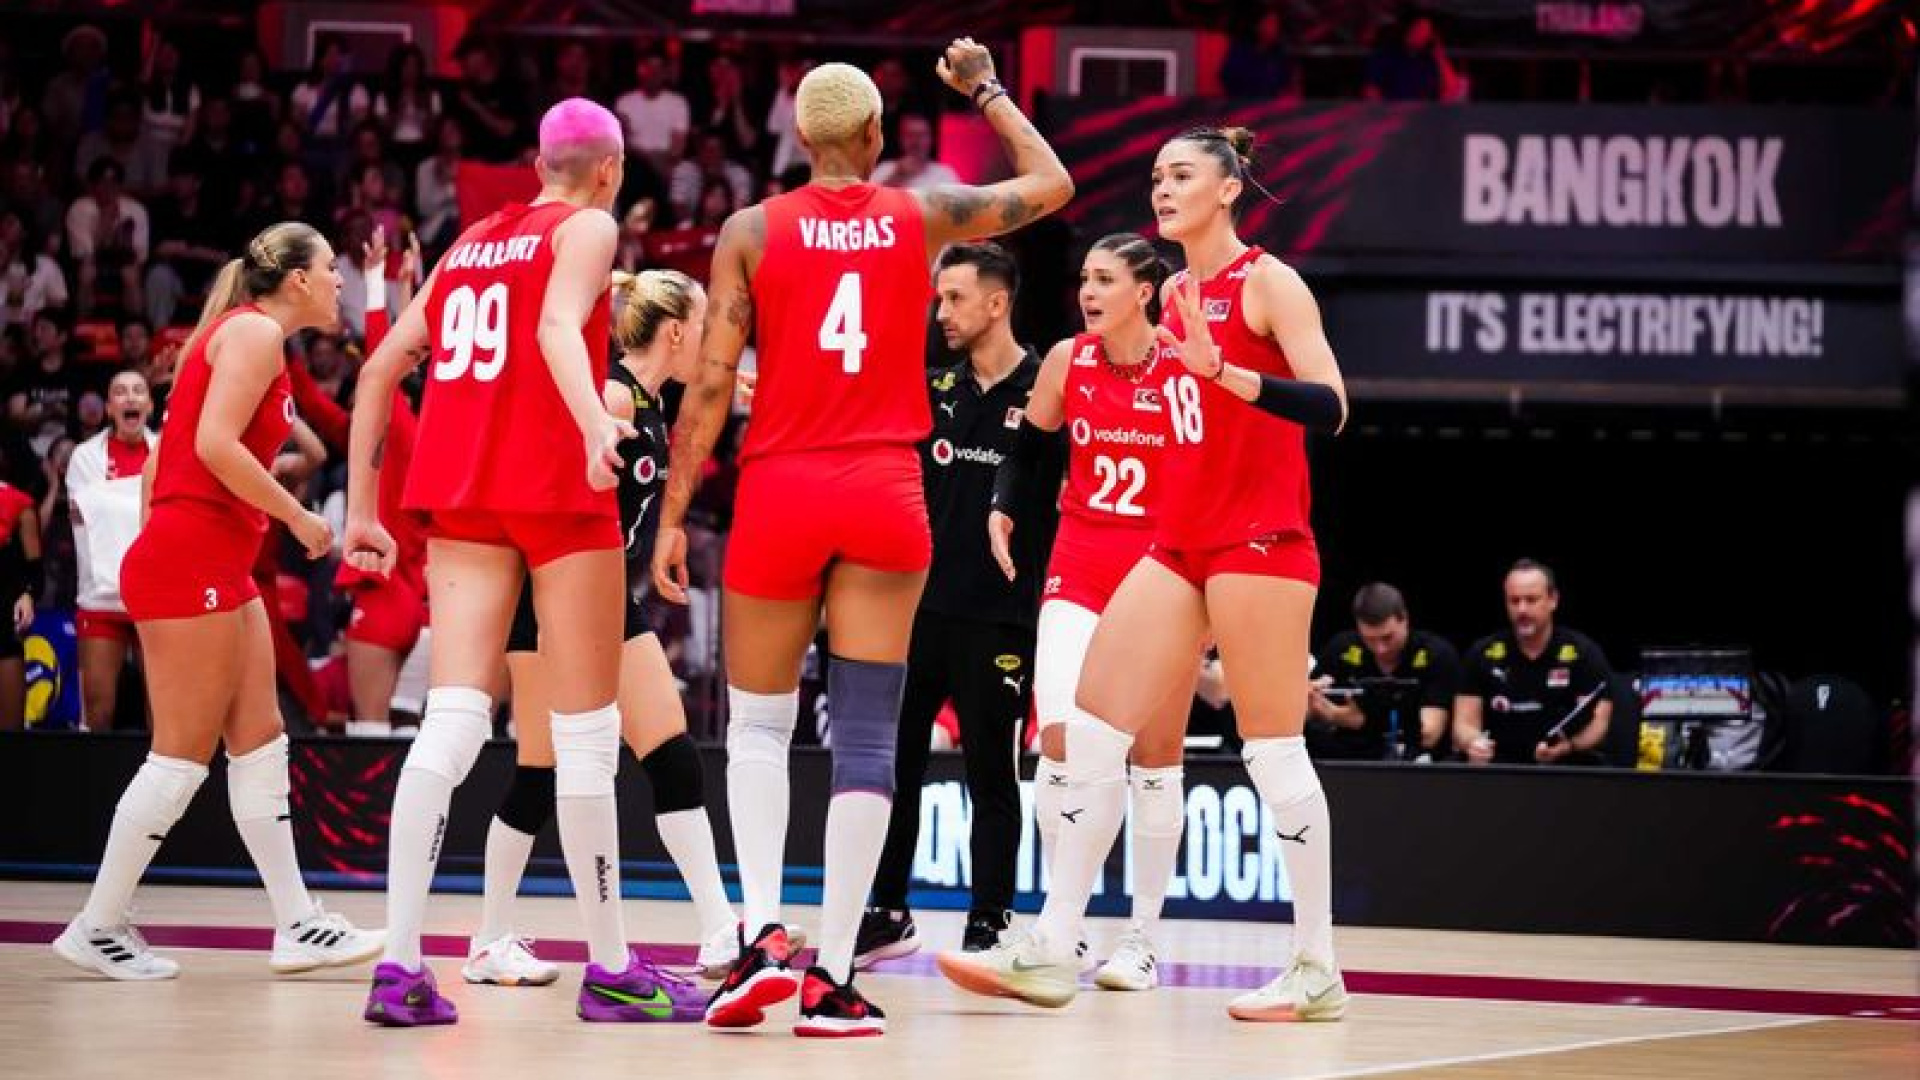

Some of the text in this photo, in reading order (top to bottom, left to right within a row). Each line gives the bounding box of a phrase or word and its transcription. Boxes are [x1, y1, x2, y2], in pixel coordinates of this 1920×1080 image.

[1463, 134, 1784, 226] BANGKOK
[799, 215, 896, 251] VARGAS
[434, 282, 510, 381] 99
[818, 270, 868, 374] 4
[1426, 293, 1824, 356] IT'S ELECTRIFYING!
[1094, 427, 1165, 447] vodafone
[1163, 375, 1204, 445] 18
[954, 446, 1005, 466] vodafo
[1088, 454, 1146, 516] 22
[204, 587, 217, 609] 3
